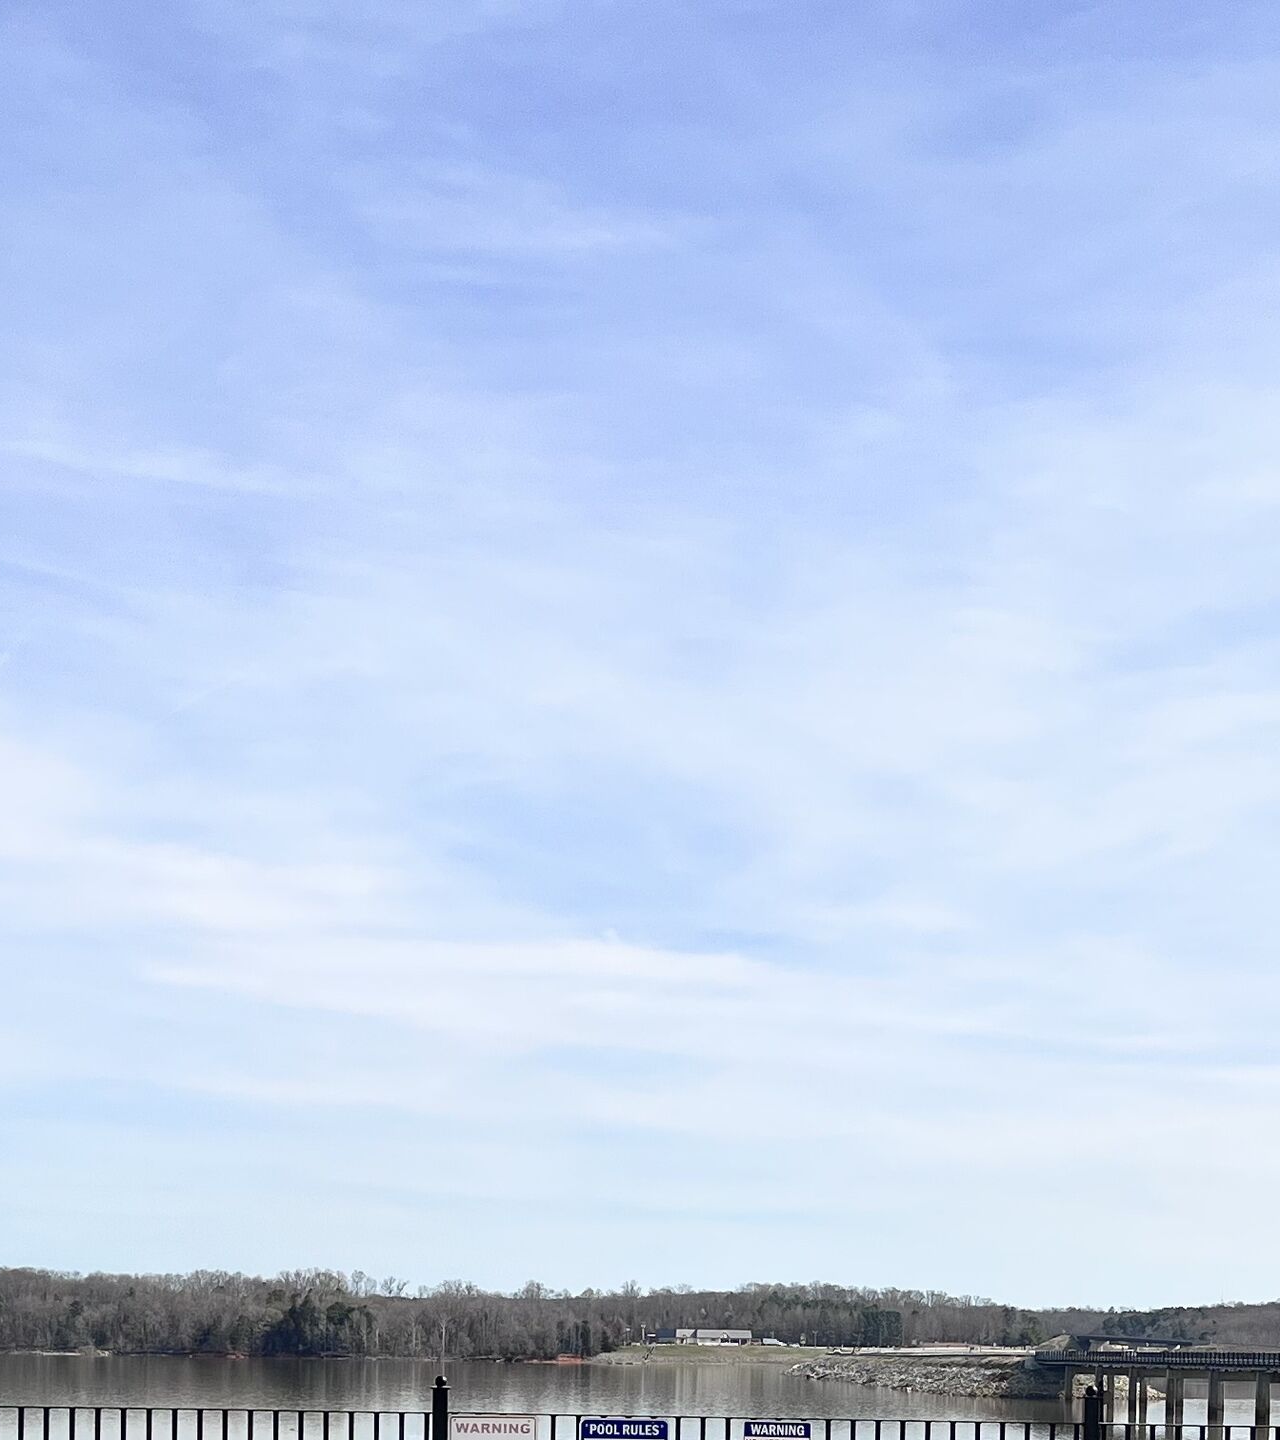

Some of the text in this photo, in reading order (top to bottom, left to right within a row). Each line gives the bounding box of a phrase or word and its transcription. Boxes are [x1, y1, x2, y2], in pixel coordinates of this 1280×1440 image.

[455, 1422, 531, 1434] WARNING
[589, 1423, 660, 1436] POOL RULES
[750, 1424, 805, 1436] WARNING
